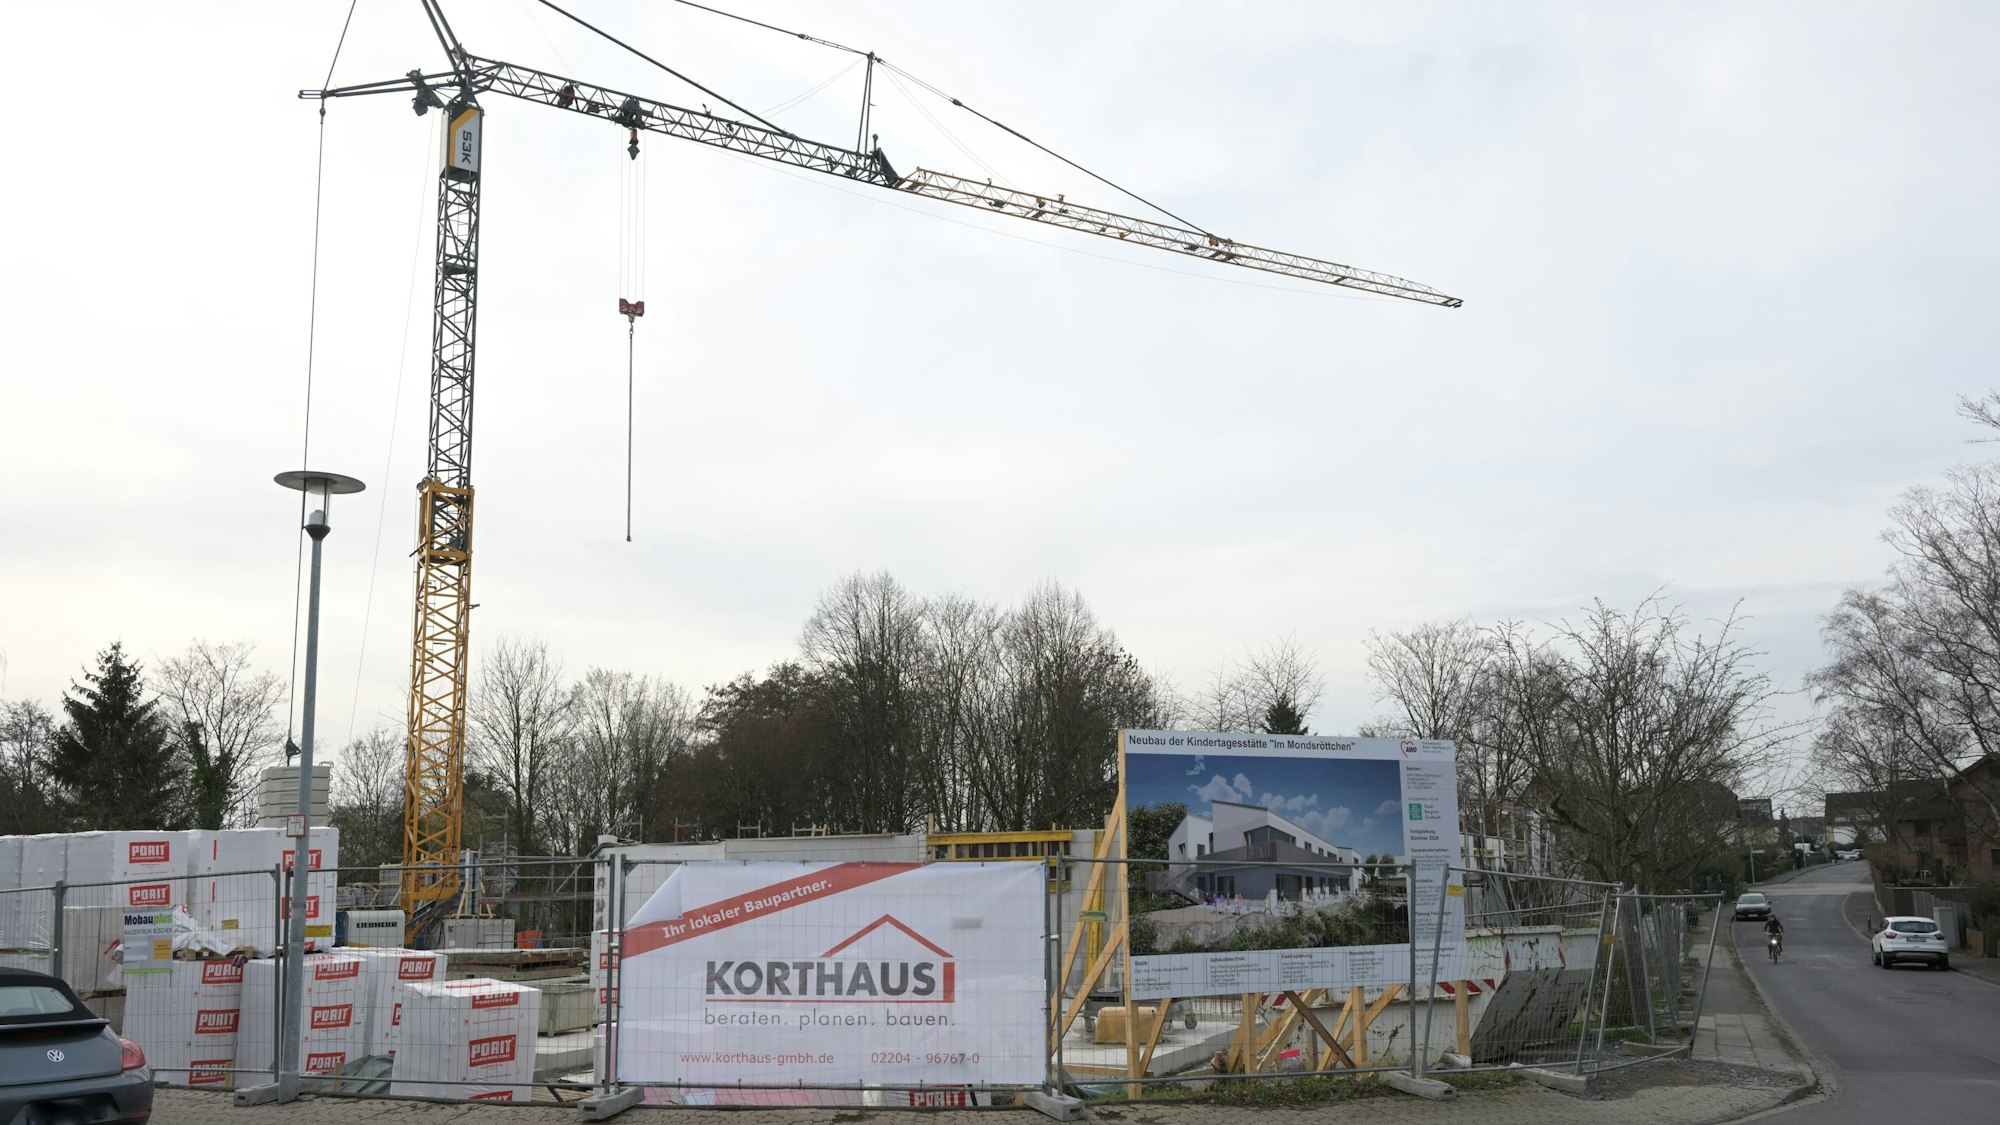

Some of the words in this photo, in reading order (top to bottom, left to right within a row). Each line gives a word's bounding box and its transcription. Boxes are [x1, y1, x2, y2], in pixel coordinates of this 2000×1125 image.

[462, 130, 472, 166] 53K
[1129, 735, 1166, 746] Neubau
[1168, 736, 1185, 746] der
[1187, 736, 1268, 749] Kindertagesstätte
[1269, 739, 1285, 749] "Im
[1287, 740, 1355, 751] Mondsröttchen"
[131, 845, 166, 857] PORIT
[132, 887, 167, 901] PORIT
[662, 922, 685, 939] Ihr
[689, 905, 741, 930] lokaler
[744, 879, 832, 914] Baupartner.
[124, 913, 173, 926] Mobauplus
[356, 921, 398, 929] LIEBHERR
[400, 961, 433, 973] PORIT
[705, 960, 936, 997] KORTHAUS
[199, 1013, 236, 1027] PORIT
[313, 1007, 349, 1022] PORIT
[704, 1008, 788, 1027] beraten.
[799, 1008, 875, 1031] planen.
[886, 1008, 956, 1027] bauen.
[470, 1039, 513, 1059] PORIT
[680, 1052, 834, 1067] www.korthaus-gmbh.de
[871, 1052, 911, 1065] 02204
[925, 1052, 980, 1065] 96767-0
